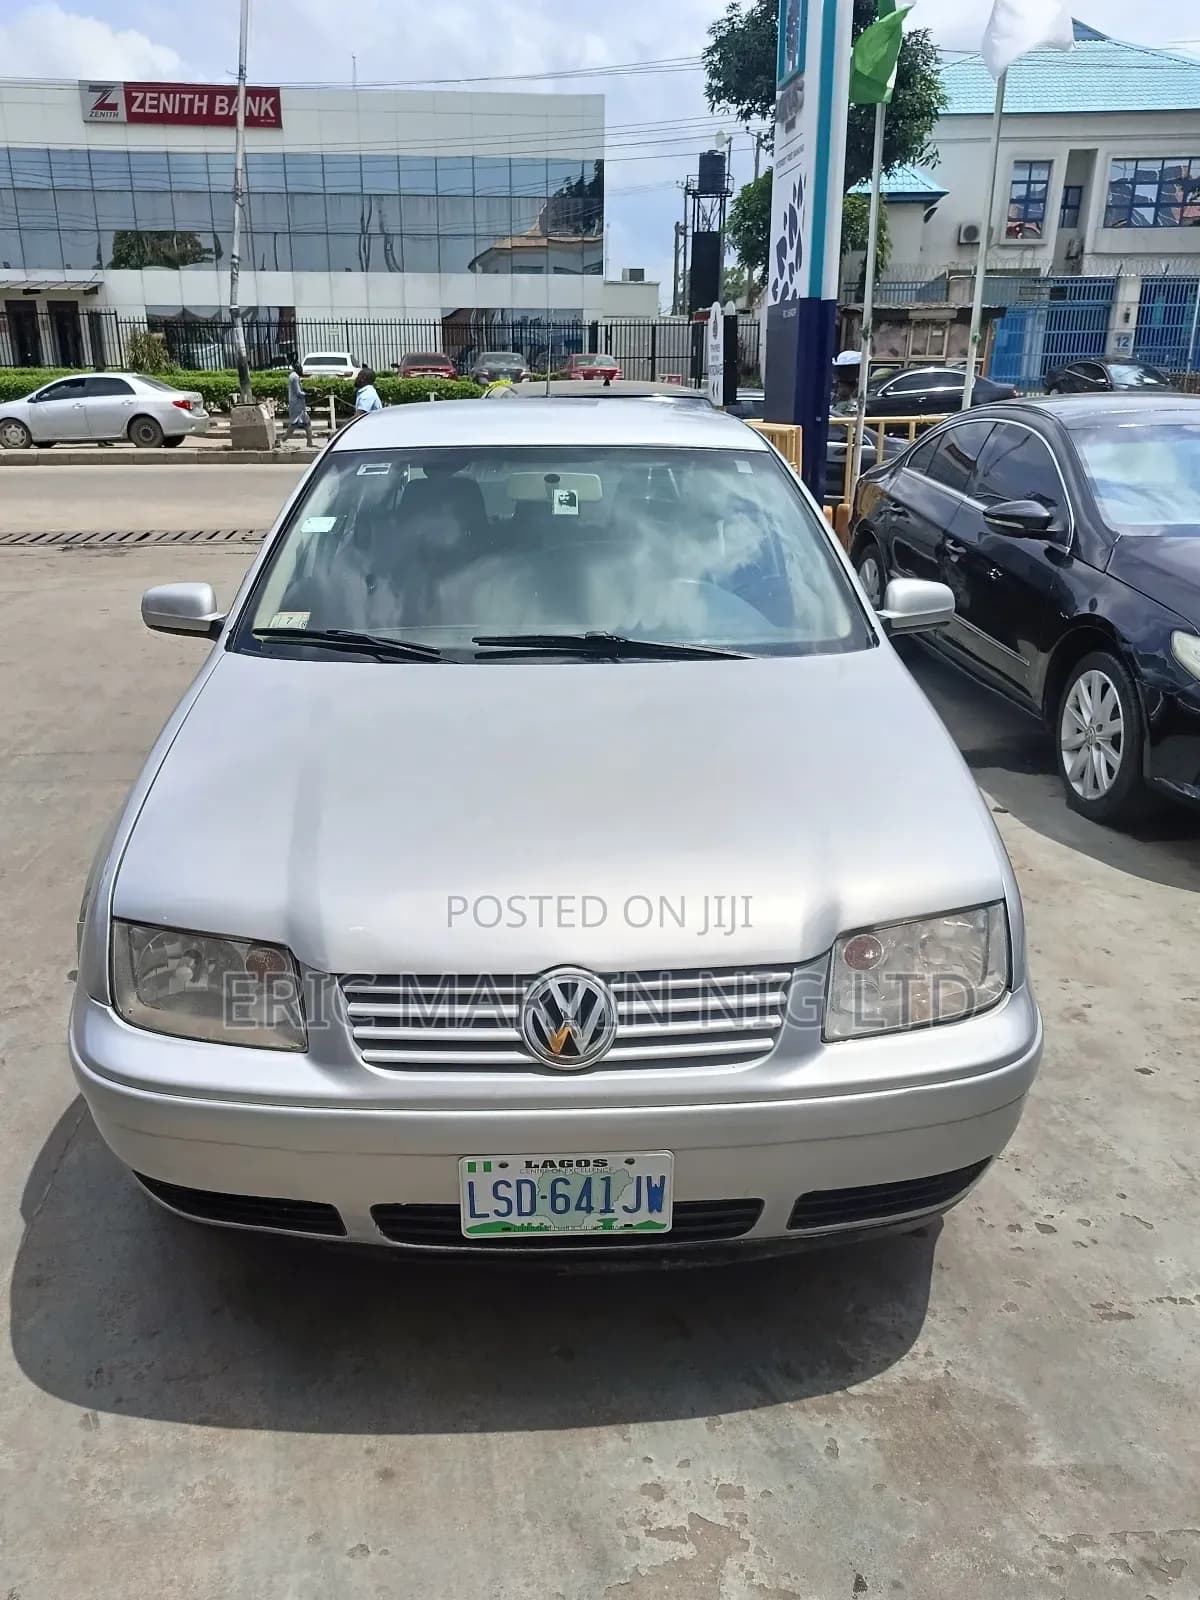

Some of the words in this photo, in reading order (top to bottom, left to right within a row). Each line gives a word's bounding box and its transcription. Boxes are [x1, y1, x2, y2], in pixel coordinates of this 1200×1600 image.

[131, 92, 208, 115] ZENITH
[214, 96, 276, 118] BANK
[1116, 336, 1130, 347] 12
[524, 1158, 609, 1169] LAGOS
